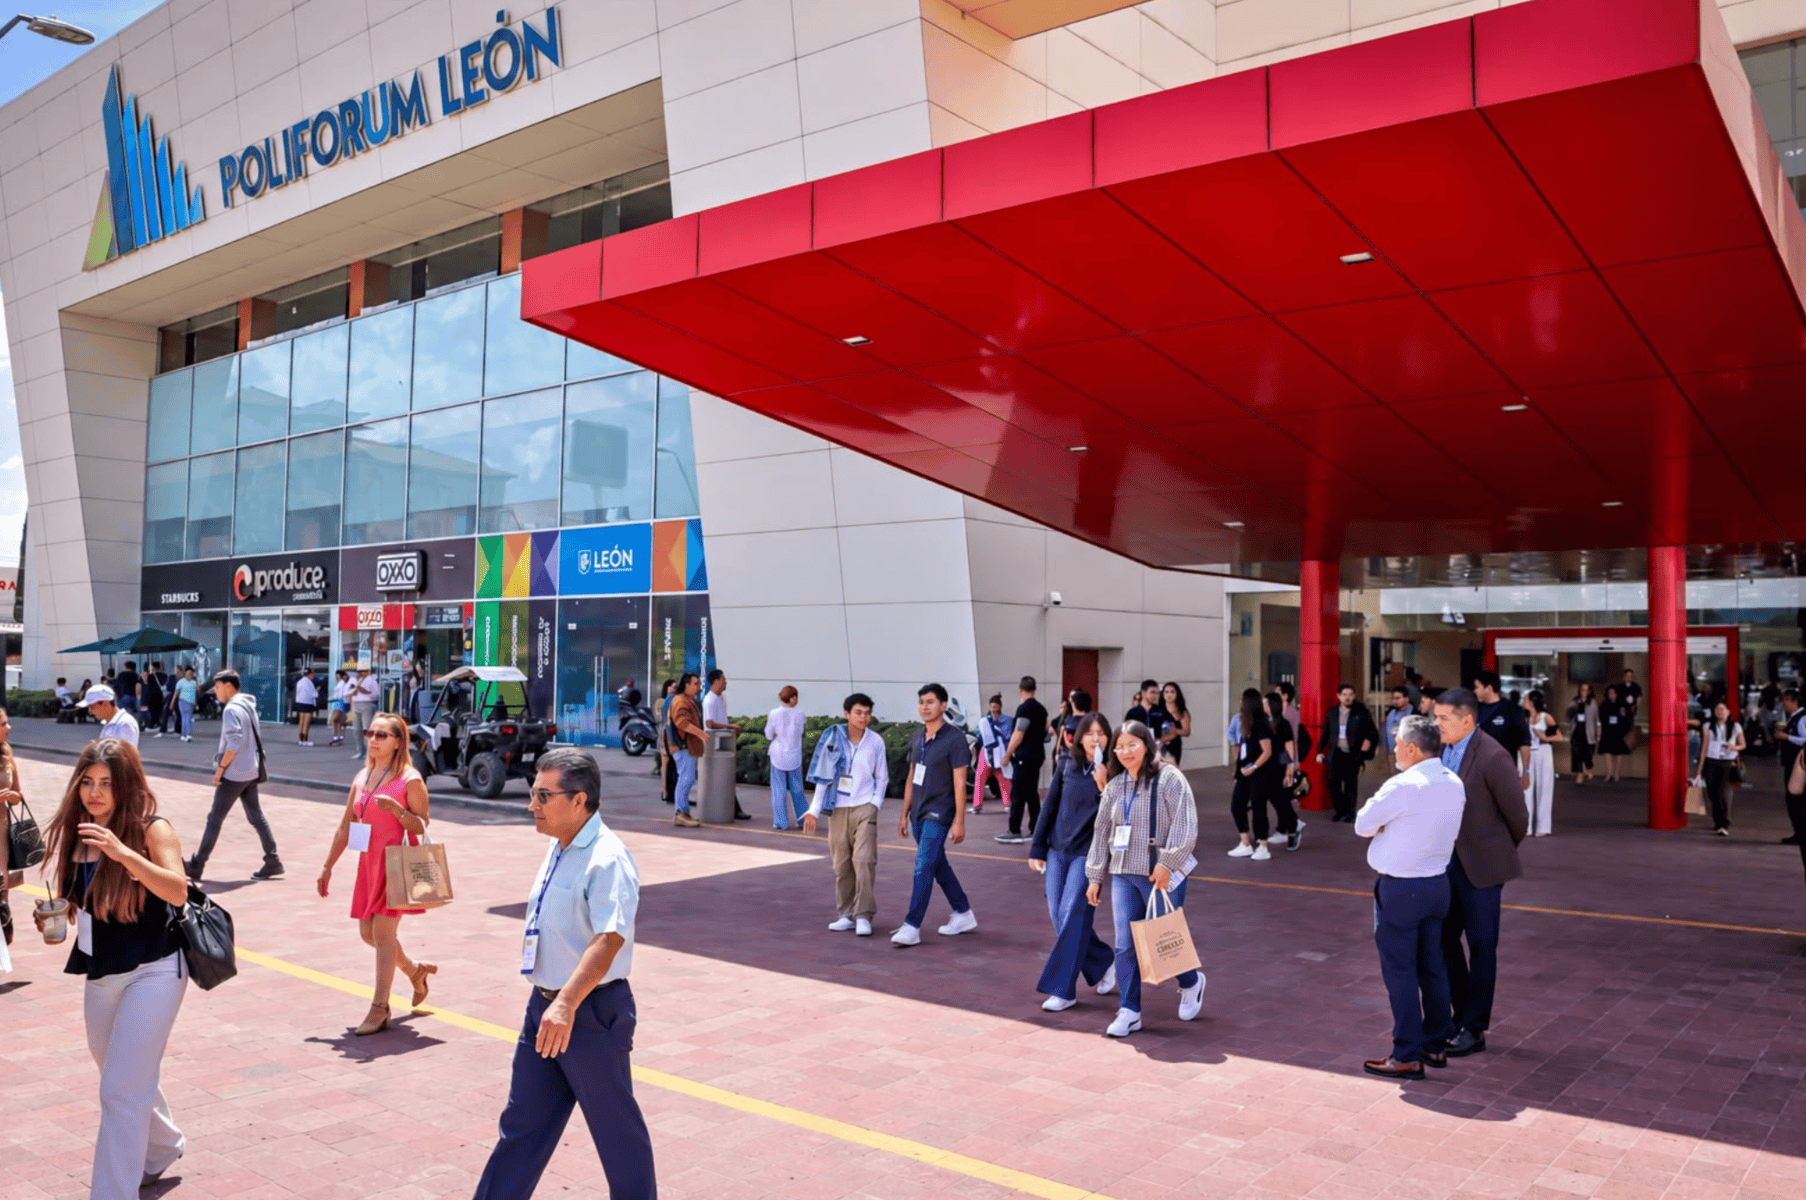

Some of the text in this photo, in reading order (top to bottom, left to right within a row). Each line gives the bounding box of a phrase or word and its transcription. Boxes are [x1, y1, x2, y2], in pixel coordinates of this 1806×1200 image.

[219, 6, 563, 208] POLIFORUM LEÓN
[594, 544, 633, 568] LEÓN
[378, 559, 416, 585] OXXO
[161, 592, 200, 604] STARBUCKS
[359, 609, 382, 626] OXXO
